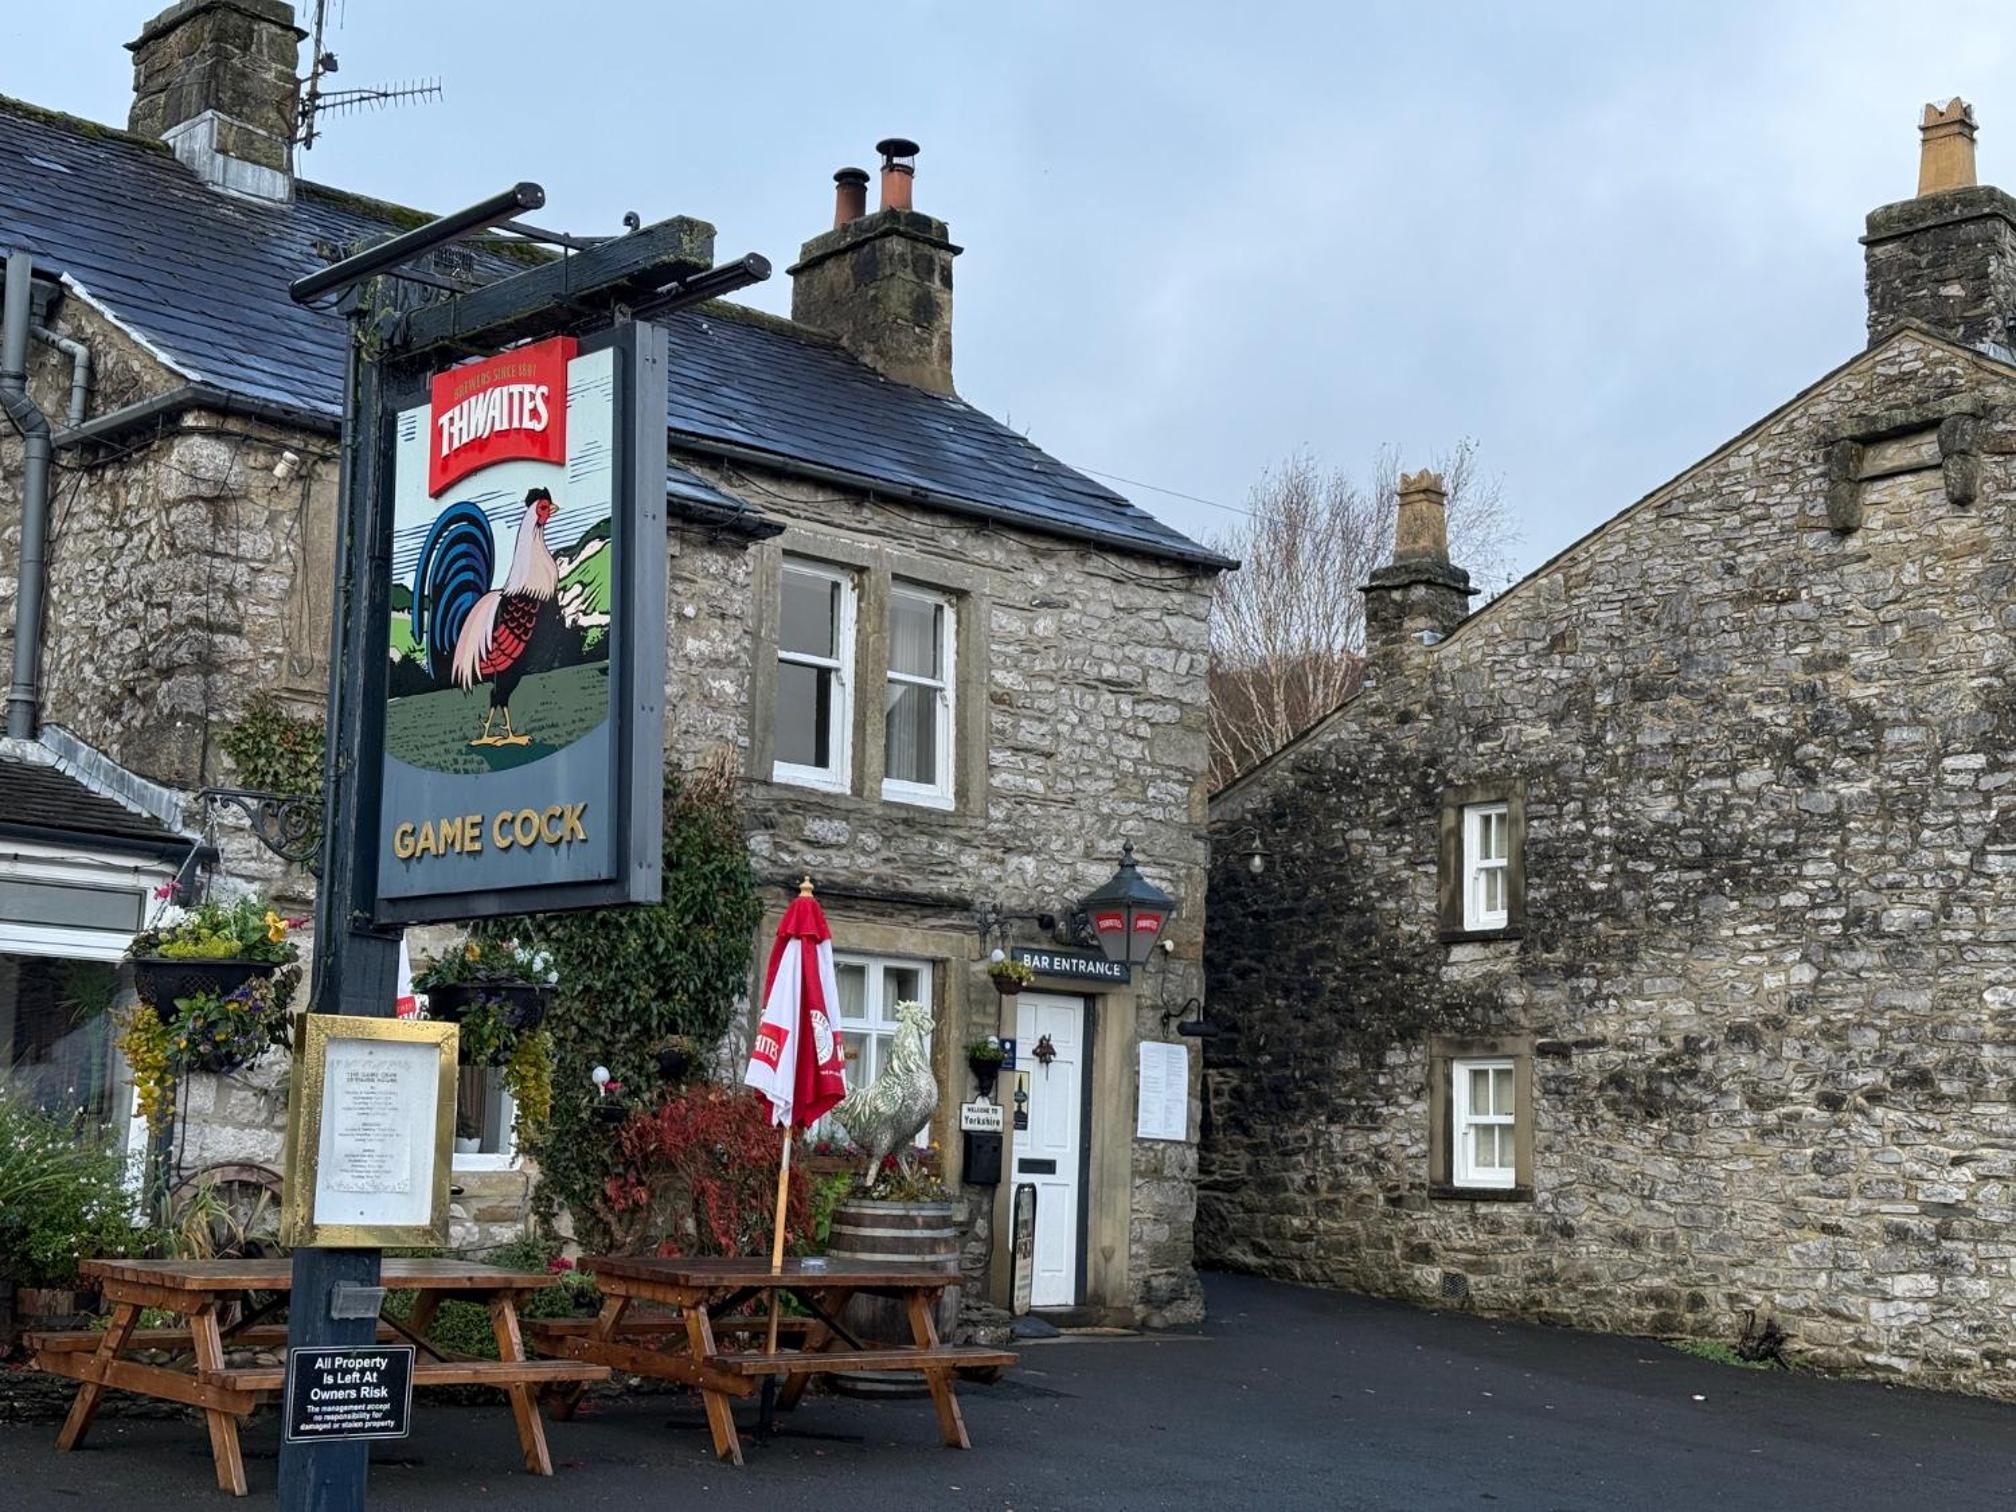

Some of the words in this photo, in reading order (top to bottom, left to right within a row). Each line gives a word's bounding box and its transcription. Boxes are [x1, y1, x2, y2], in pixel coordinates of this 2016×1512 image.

[453, 370, 492, 400] BREWERS
[493, 364, 517, 382] SINCE
[438, 384, 549, 459] THWAITES
[394, 815, 484, 859] GAME
[493, 802, 588, 849] COCK
[1023, 954, 1049, 969] BAR
[1053, 957, 1121, 976] ENTRANCE
[964, 1114, 1000, 1127] Yorkshire
[314, 1357, 332, 1369] All
[334, 1356, 388, 1370] Property
[323, 1372, 335, 1384] Is
[337, 1371, 360, 1384] Left
[362, 1371, 377, 1383] At
[310, 1388, 357, 1400] Owners
[360, 1386, 388, 1399] Risk
[306, 1405, 320, 1413] The
[321, 1403, 366, 1413] management
[367, 1403, 391, 1412] accept
[324, 1411, 371, 1421] responsibility
[372, 1411, 383, 1419] for
[300, 1421, 332, 1431] damaged
[364, 1419, 396, 1429] property
